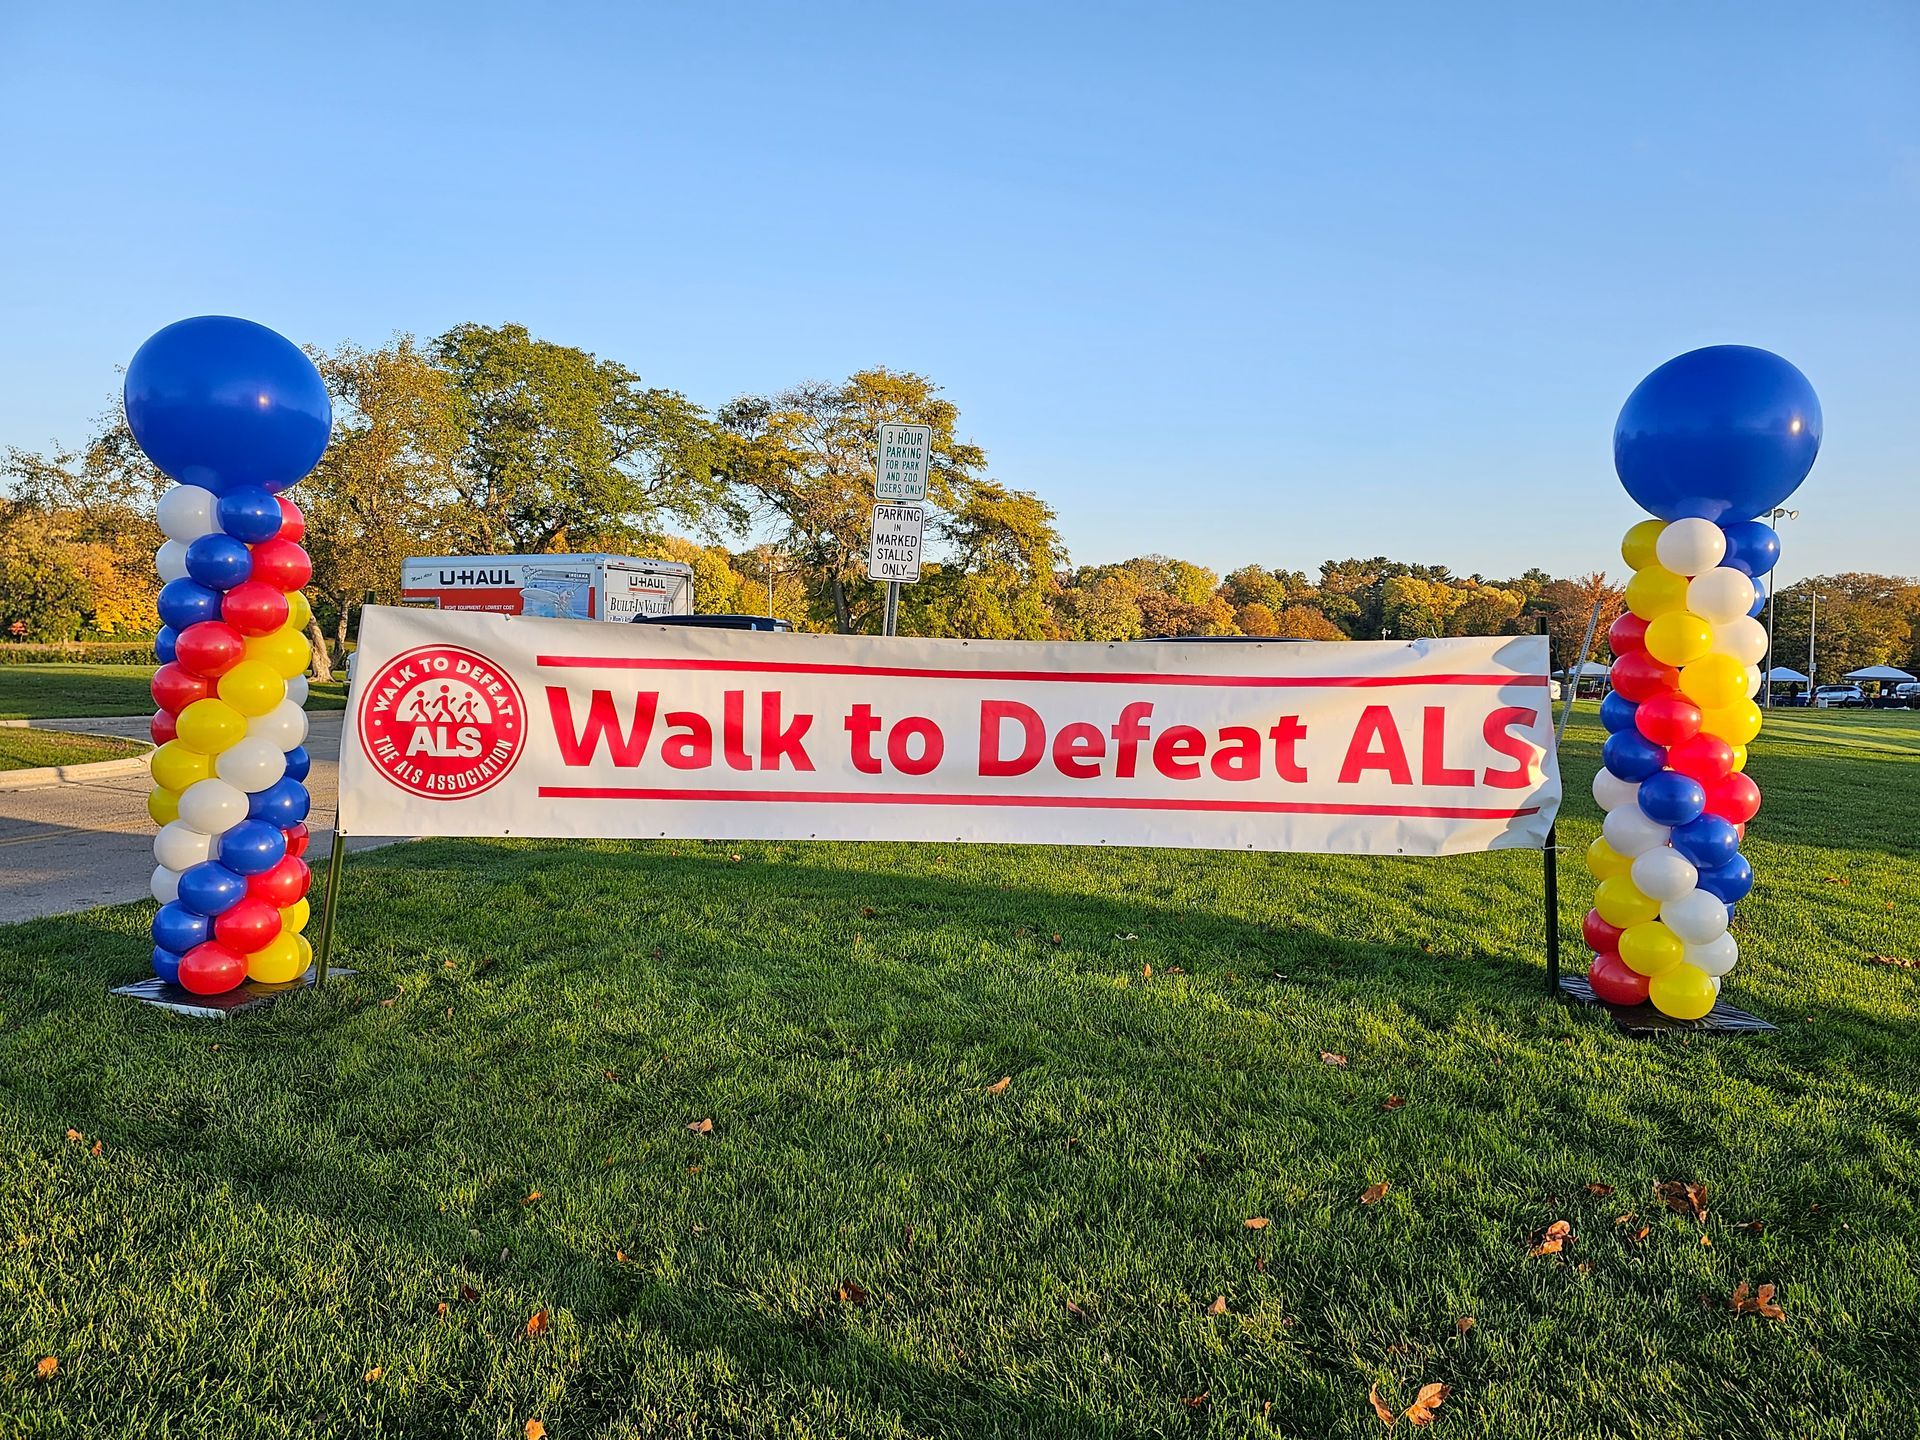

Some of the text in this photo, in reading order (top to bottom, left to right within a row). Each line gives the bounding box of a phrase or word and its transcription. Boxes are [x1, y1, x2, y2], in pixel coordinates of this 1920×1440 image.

[887, 431, 923, 446] 3 HOUR
[886, 447, 921, 459] PARKING
[885, 460, 919, 470] FOR PARK
[886, 472, 918, 483] AND ZOO
[879, 483, 923, 495] USERS ONLY
[877, 508, 920, 522] PARKING
[893, 524, 901, 532] IN
[876, 533, 918, 547] MARKED
[876, 548, 913, 562] STALLS
[882, 563, 907, 576] ONLY
[440, 570, 515, 585] U-HAUL
[629, 576, 666, 589] U-HAUL
[644, 599, 671, 615] VALUE!
[373, 657, 514, 716] WALK TO DEFEAT
[405, 726, 482, 758] ALS
[545, 685, 1538, 790] Walk to Defeat ALS
[373, 735, 513, 791] THE ALS ASSOCIATION
